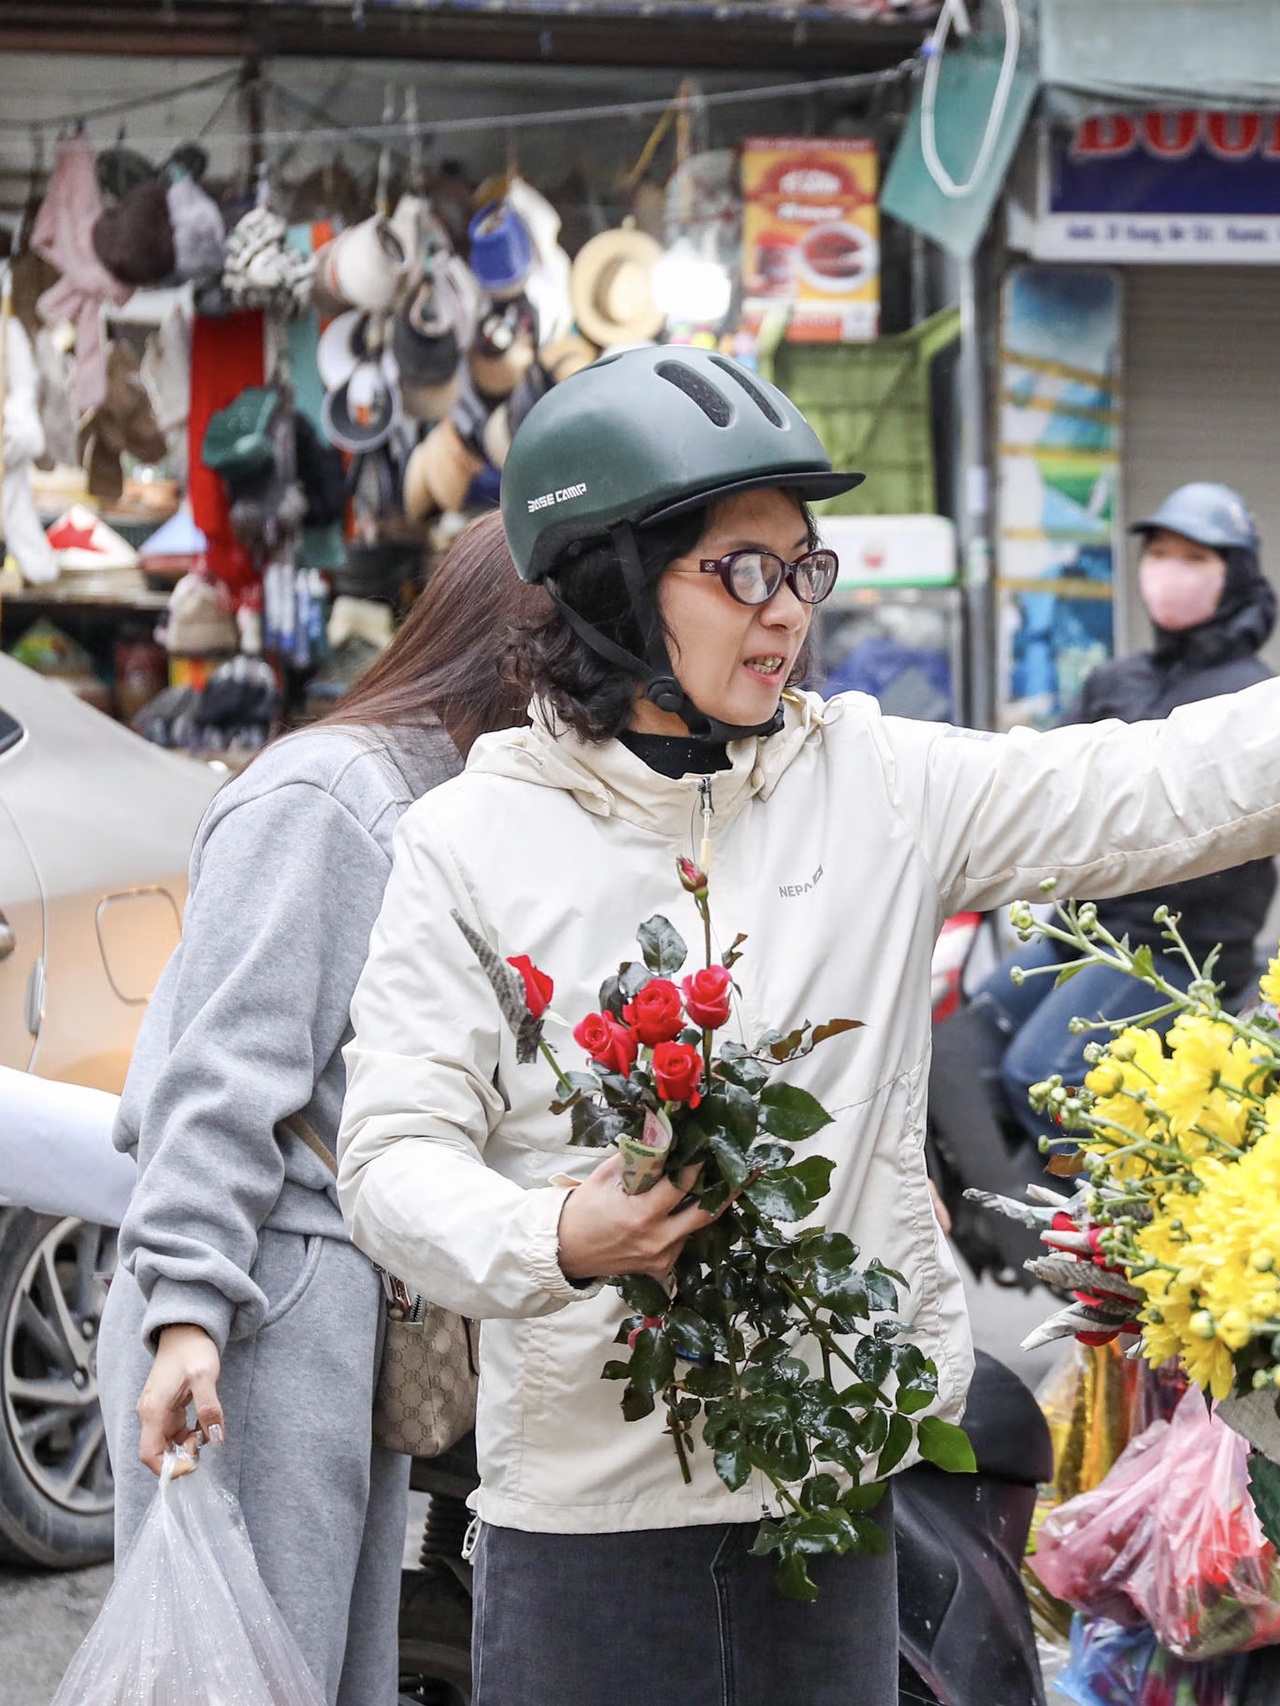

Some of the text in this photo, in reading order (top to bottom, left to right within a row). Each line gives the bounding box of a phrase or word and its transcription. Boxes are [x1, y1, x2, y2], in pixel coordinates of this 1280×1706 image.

[526, 482, 587, 513] BASE CAMP
[778, 882, 813, 898] NEPA
